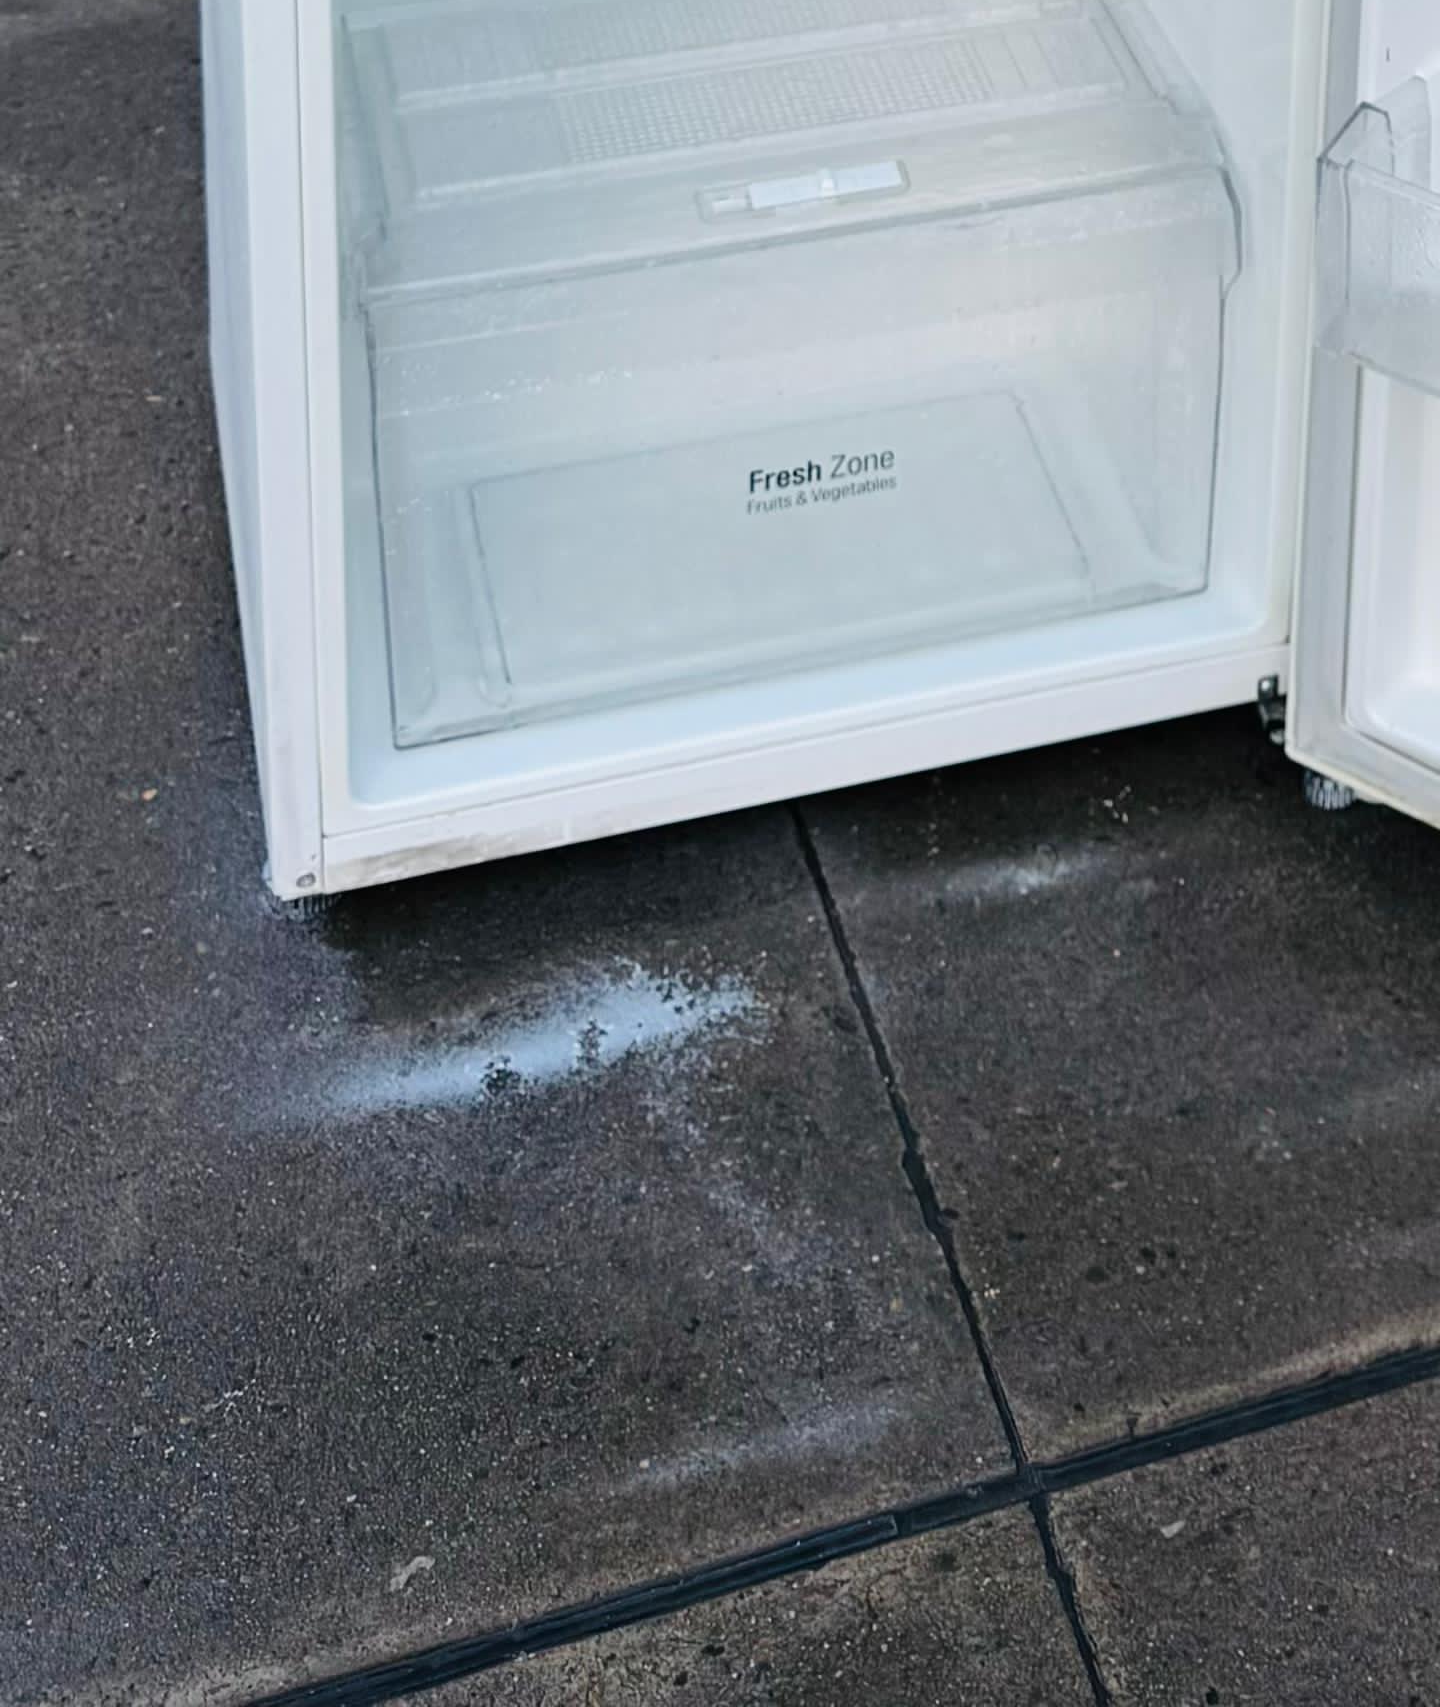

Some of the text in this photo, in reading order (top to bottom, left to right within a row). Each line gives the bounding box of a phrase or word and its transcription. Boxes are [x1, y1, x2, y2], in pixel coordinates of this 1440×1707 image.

[750, 450, 895, 494] Fresh Zone
[747, 477, 897, 515] Fruits & Vegetables
